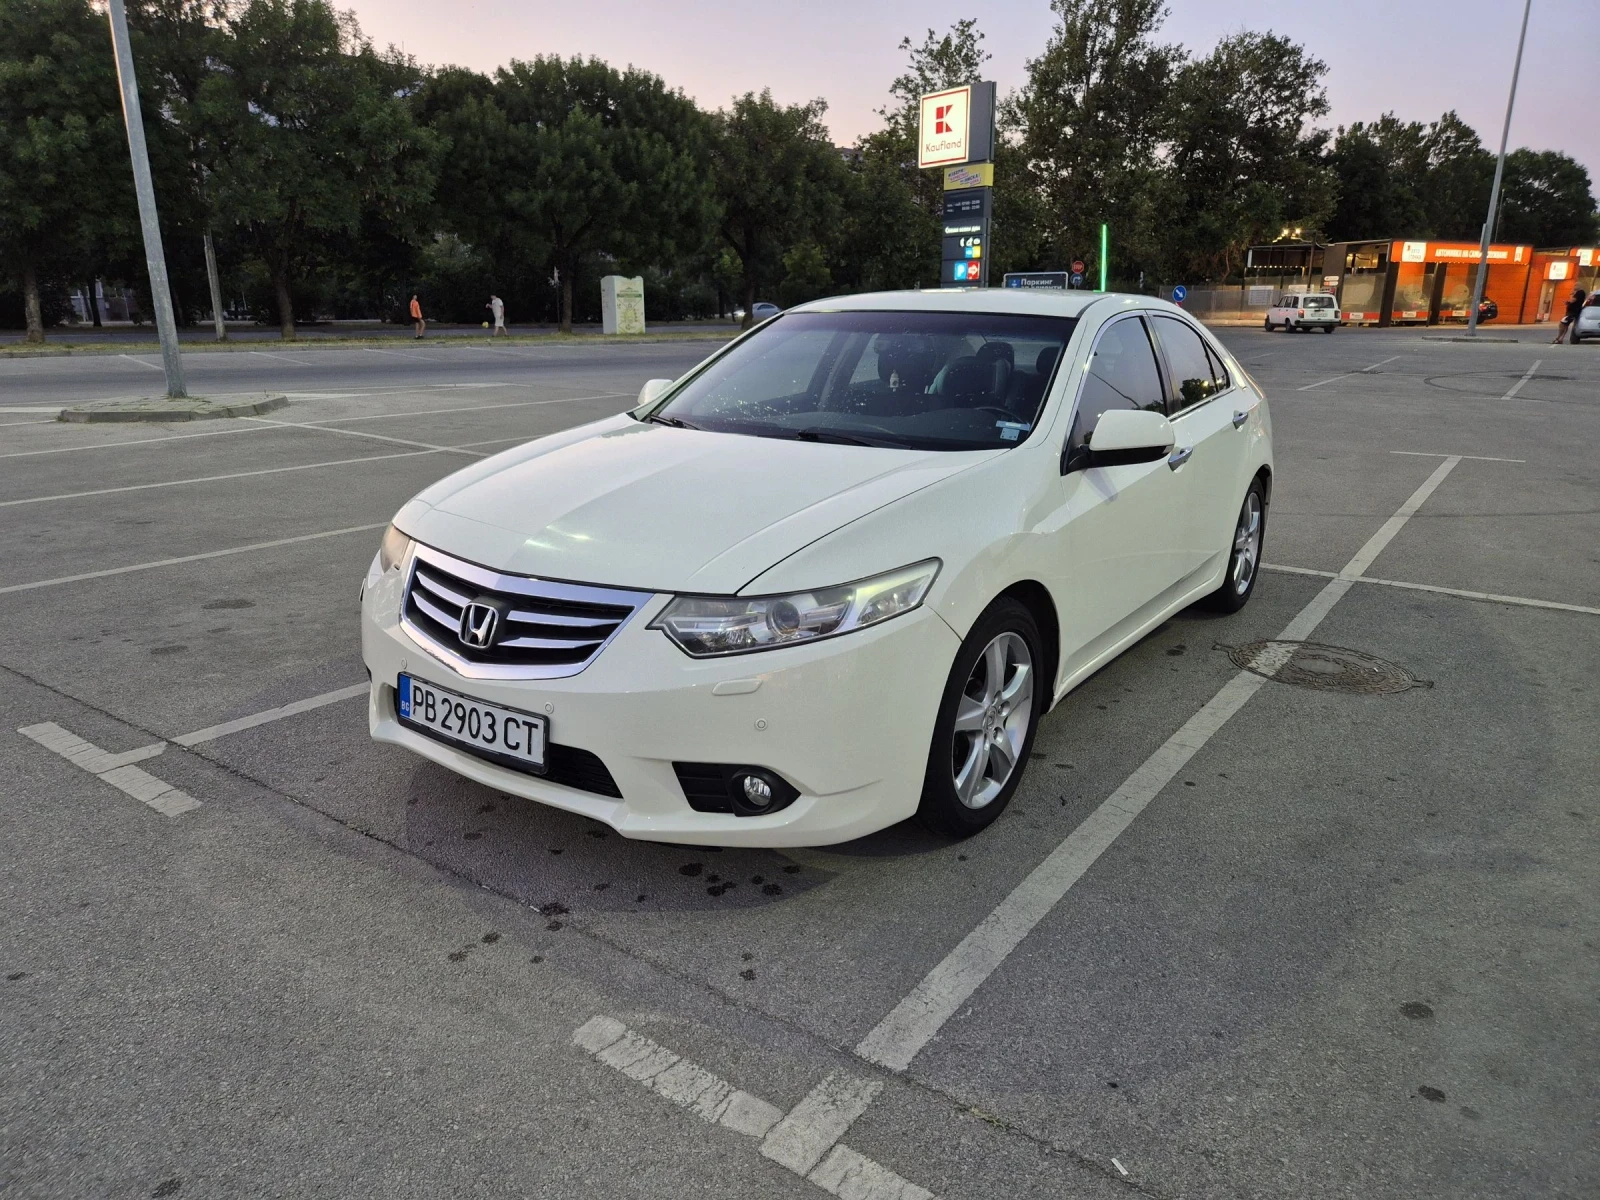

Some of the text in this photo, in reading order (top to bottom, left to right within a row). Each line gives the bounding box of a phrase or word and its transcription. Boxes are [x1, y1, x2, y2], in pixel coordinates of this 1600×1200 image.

[925, 138, 962, 153] Kaufland
[1021, 278, 1054, 287] Паркинг
[401, 700, 410, 712] BG
[412, 684, 539, 756] PB 2903 CT
